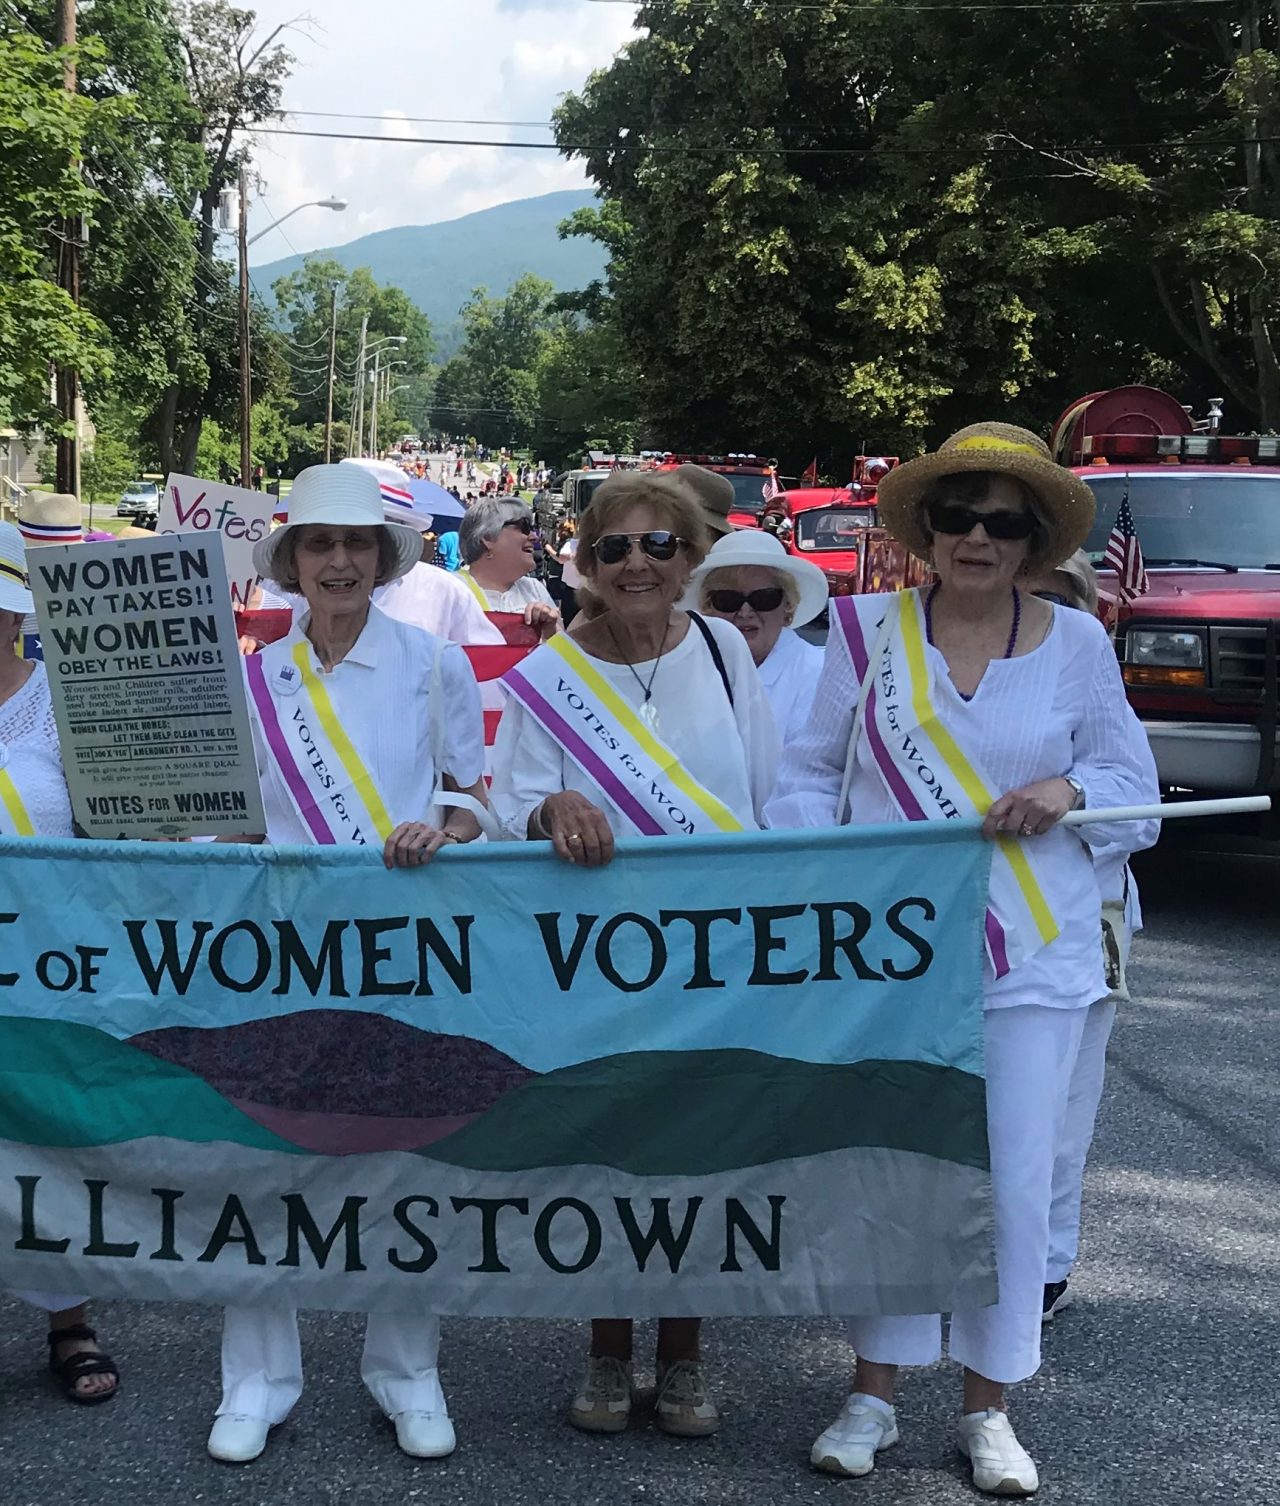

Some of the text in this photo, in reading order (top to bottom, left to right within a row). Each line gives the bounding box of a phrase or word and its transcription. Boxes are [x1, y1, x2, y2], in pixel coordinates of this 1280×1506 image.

[170, 485, 266, 542] Votes
[38, 549, 209, 594] WOMEN
[47, 597, 95, 619] PAY
[103, 585, 213, 614] TAXES!!
[51, 615, 219, 656] WOMEN
[58, 649, 224, 675] OBEY THE LAWS!
[62, 675, 227, 694] Women and Children suffer from
[64, 692, 85, 702] dirty
[124, 689, 159, 699] impure
[67, 709, 97, 718] smoke
[114, 697, 131, 706] bad
[135, 695, 173, 707] sanitary
[71, 725, 97, 734] WOMEN
[99, 723, 122, 732] CLEAN
[125, 722, 139, 731] THE
[113, 728, 235, 743] LET THEM HELP CLEAN THE CITY
[557, 677, 620, 751] VOTES
[620, 753, 646, 782] for
[134, 746, 179, 756] AMENDMENT
[886, 704, 901, 732] for
[902, 733, 962, 819] WOME
[173, 761, 211, 770] SQUARE
[292, 705, 351, 823] VOTES for
[86, 791, 247, 816] VOTES FOR WOMEN
[35, 945, 108, 994] OF
[122, 914, 476, 997] WOMEN
[533, 895, 936, 994] VOTERS
